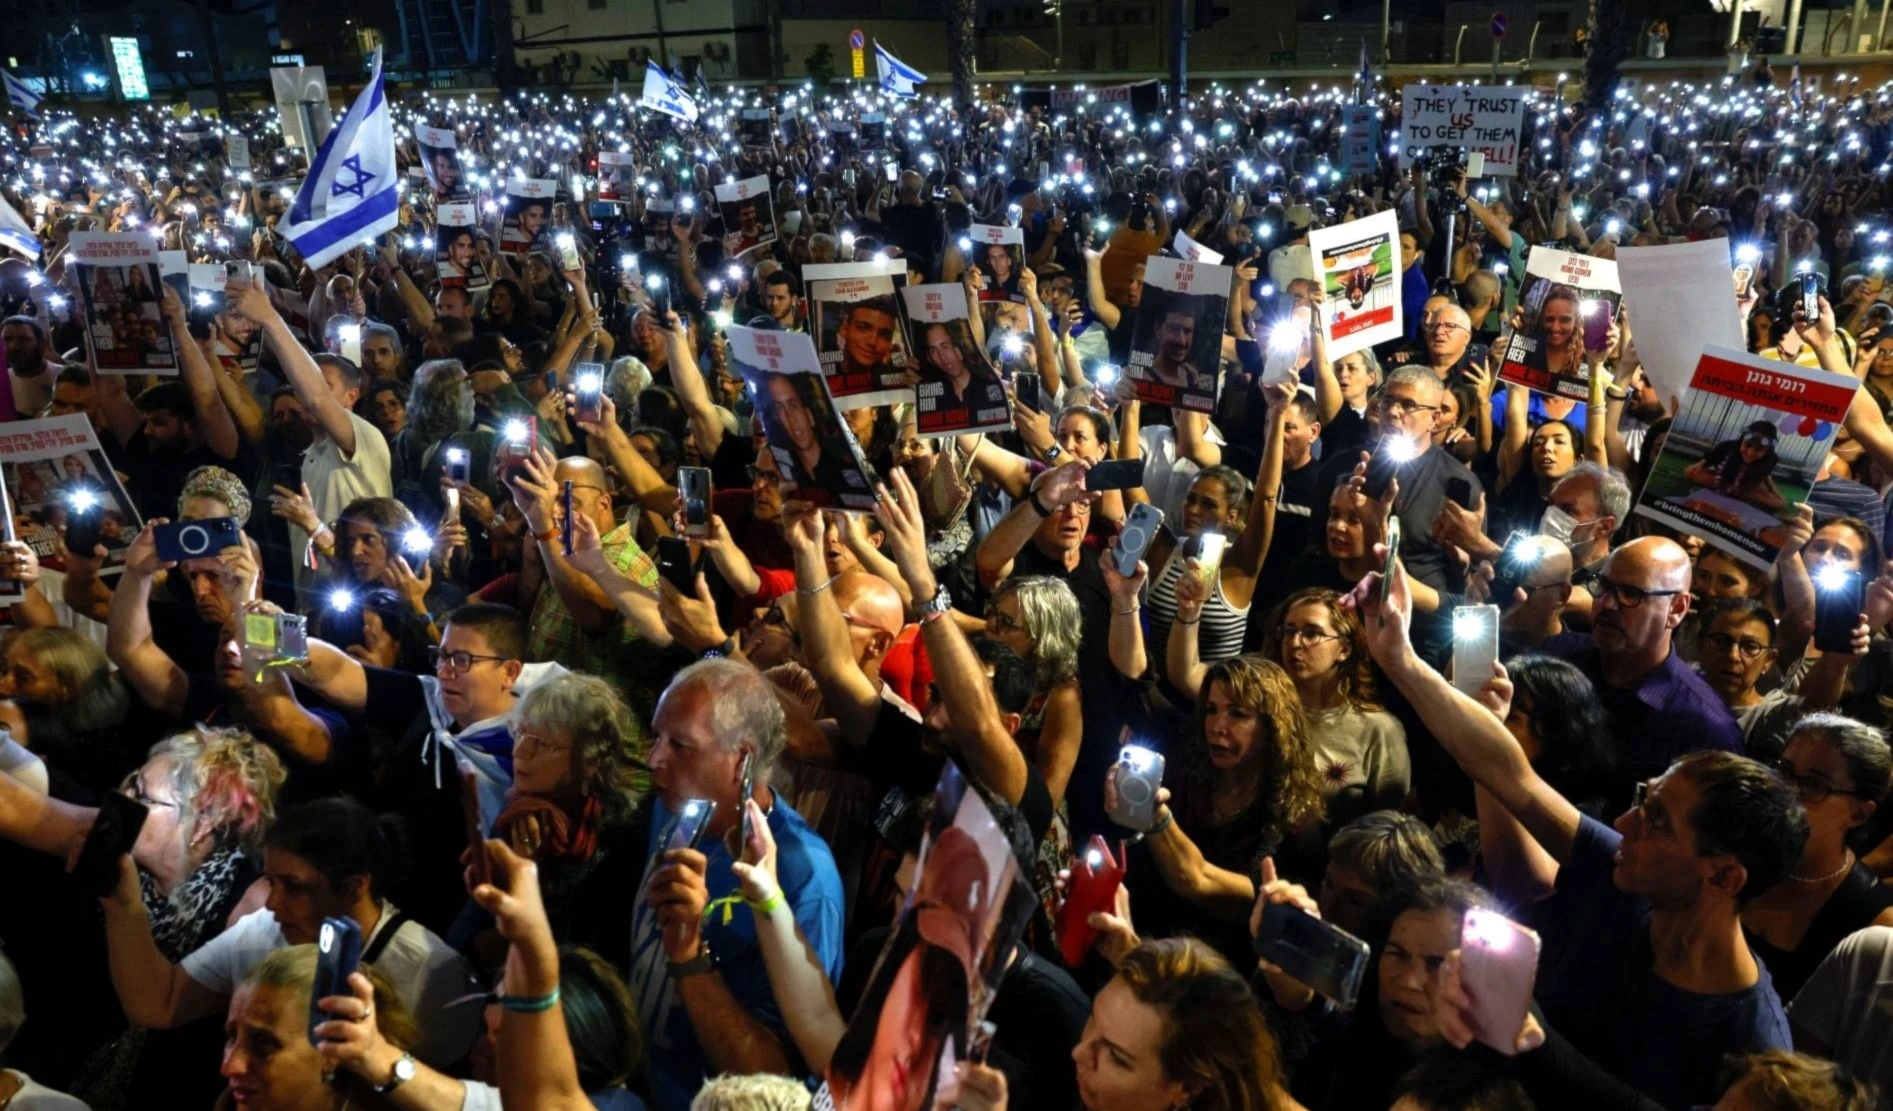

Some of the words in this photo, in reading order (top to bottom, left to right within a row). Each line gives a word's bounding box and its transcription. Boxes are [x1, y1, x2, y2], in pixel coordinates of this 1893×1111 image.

[1414, 98, 1457, 113] THEY
[1465, 98, 1519, 114] TRUST
[1451, 114, 1474, 128] US
[1409, 125, 1431, 139] TO
[1436, 125, 1467, 140] GET
[1474, 127, 1517, 145] THEM
[1511, 334, 1538, 353] BRING
[819, 350, 844, 366] BRING
[1130, 350, 1154, 368] BRING
[1507, 348, 1526, 364] HER
[1745, 369, 1773, 387] גונן
[1775, 377, 1807, 394] רומי
[919, 381, 944, 398] BRING
[919, 397, 937, 413] HIM
[1653, 499, 1766, 553] #bringthemhomenow
